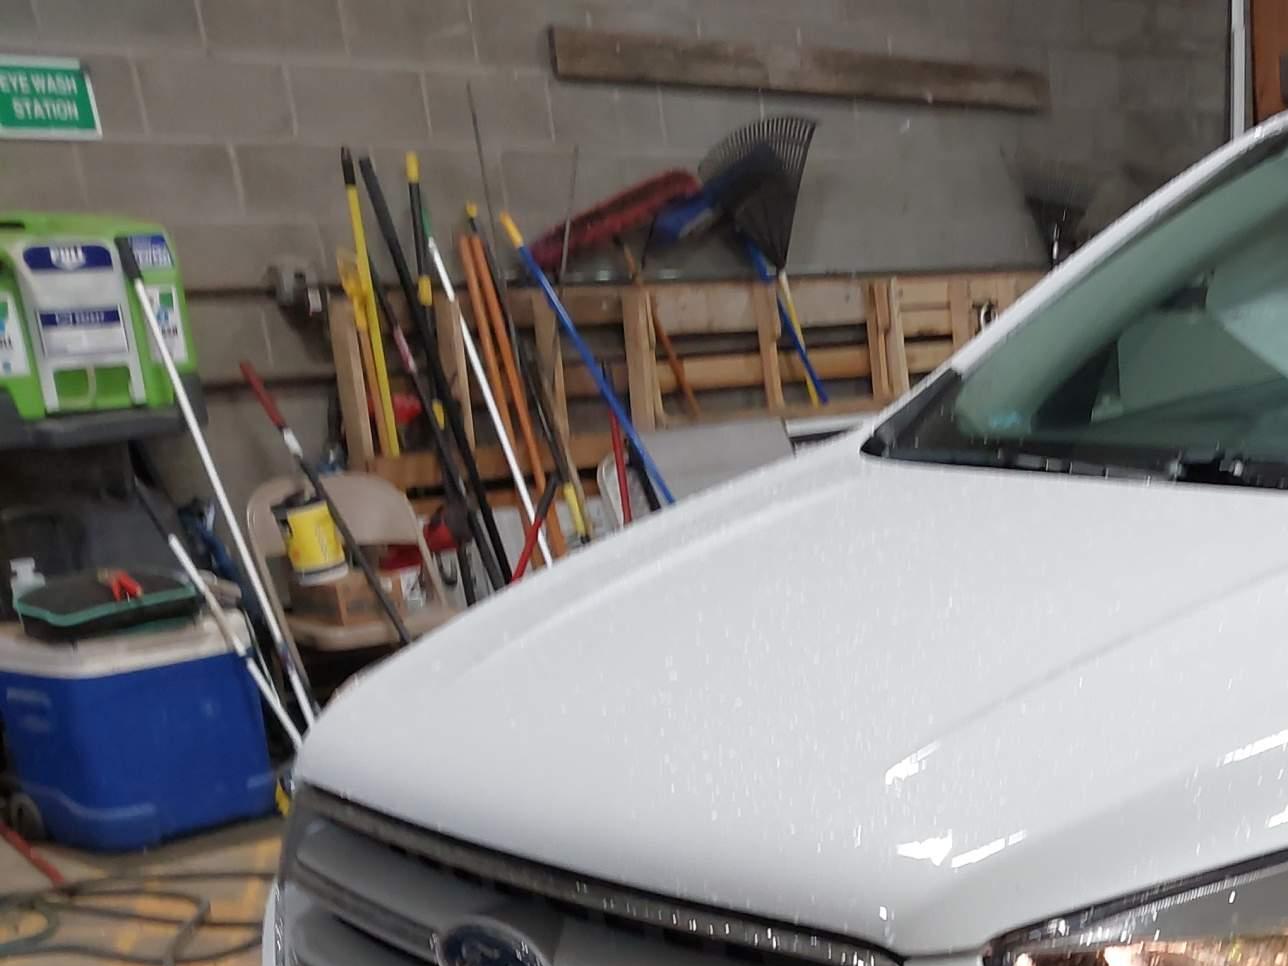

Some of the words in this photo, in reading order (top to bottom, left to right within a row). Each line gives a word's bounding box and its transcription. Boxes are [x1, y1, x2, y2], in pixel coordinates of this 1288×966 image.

[0, 73, 31, 94] EYE
[31, 73, 78, 95] WASH
[13, 96, 79, 121] STATION
